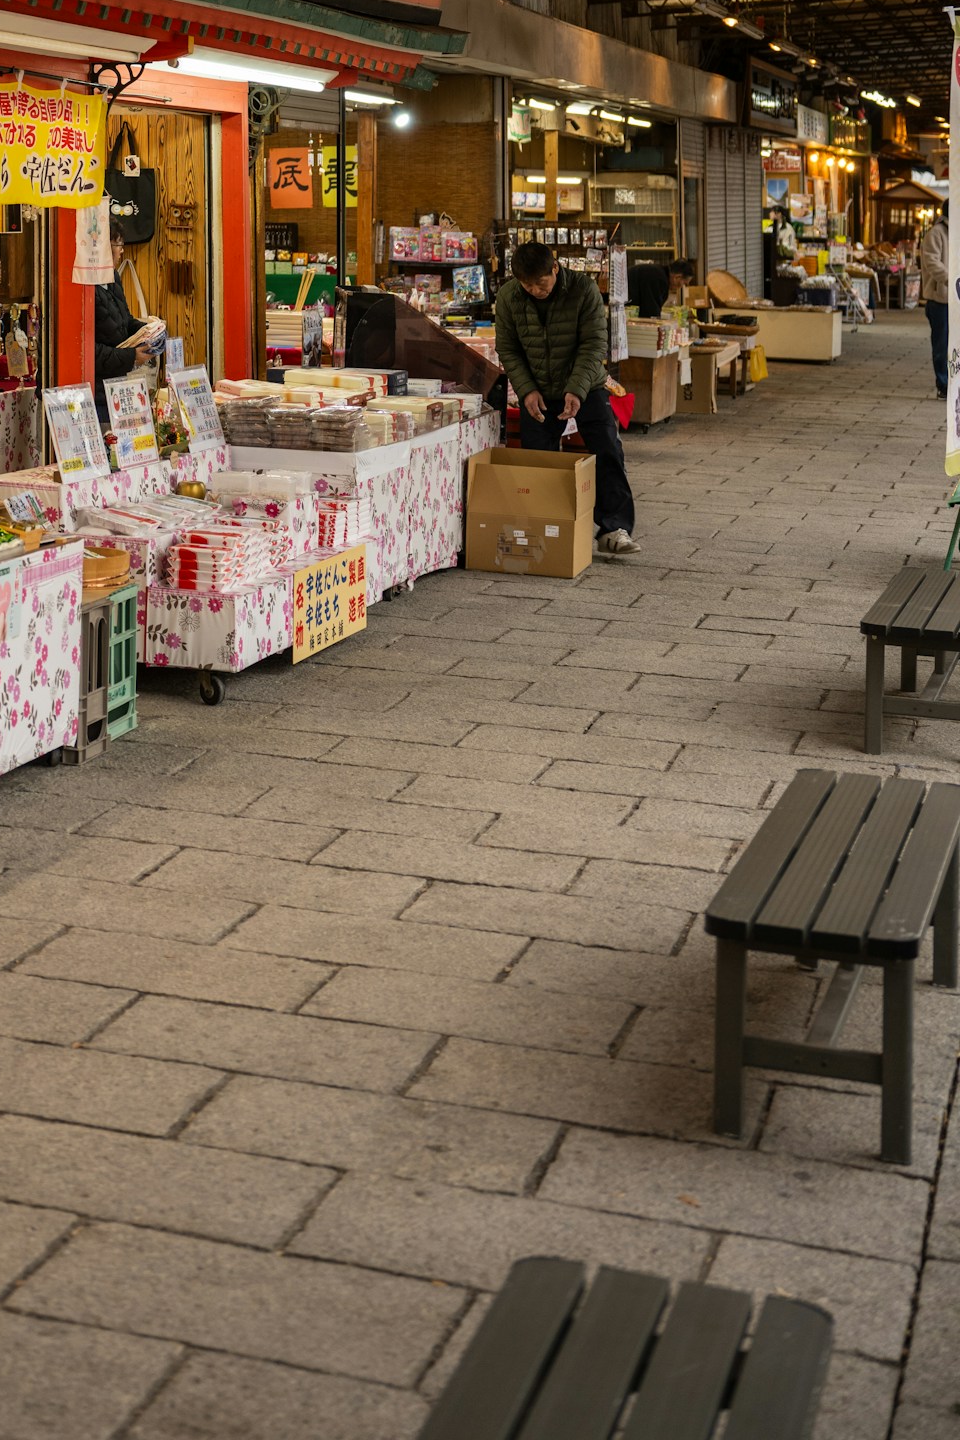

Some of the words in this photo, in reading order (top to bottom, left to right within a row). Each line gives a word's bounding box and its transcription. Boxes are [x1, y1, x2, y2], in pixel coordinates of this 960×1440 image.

[273, 157, 309, 191] 辰
[305, 556, 348, 601] 宇佐だんご
[296, 581, 304, 650] 名物
[305, 592, 340, 632] 宇佐もち
